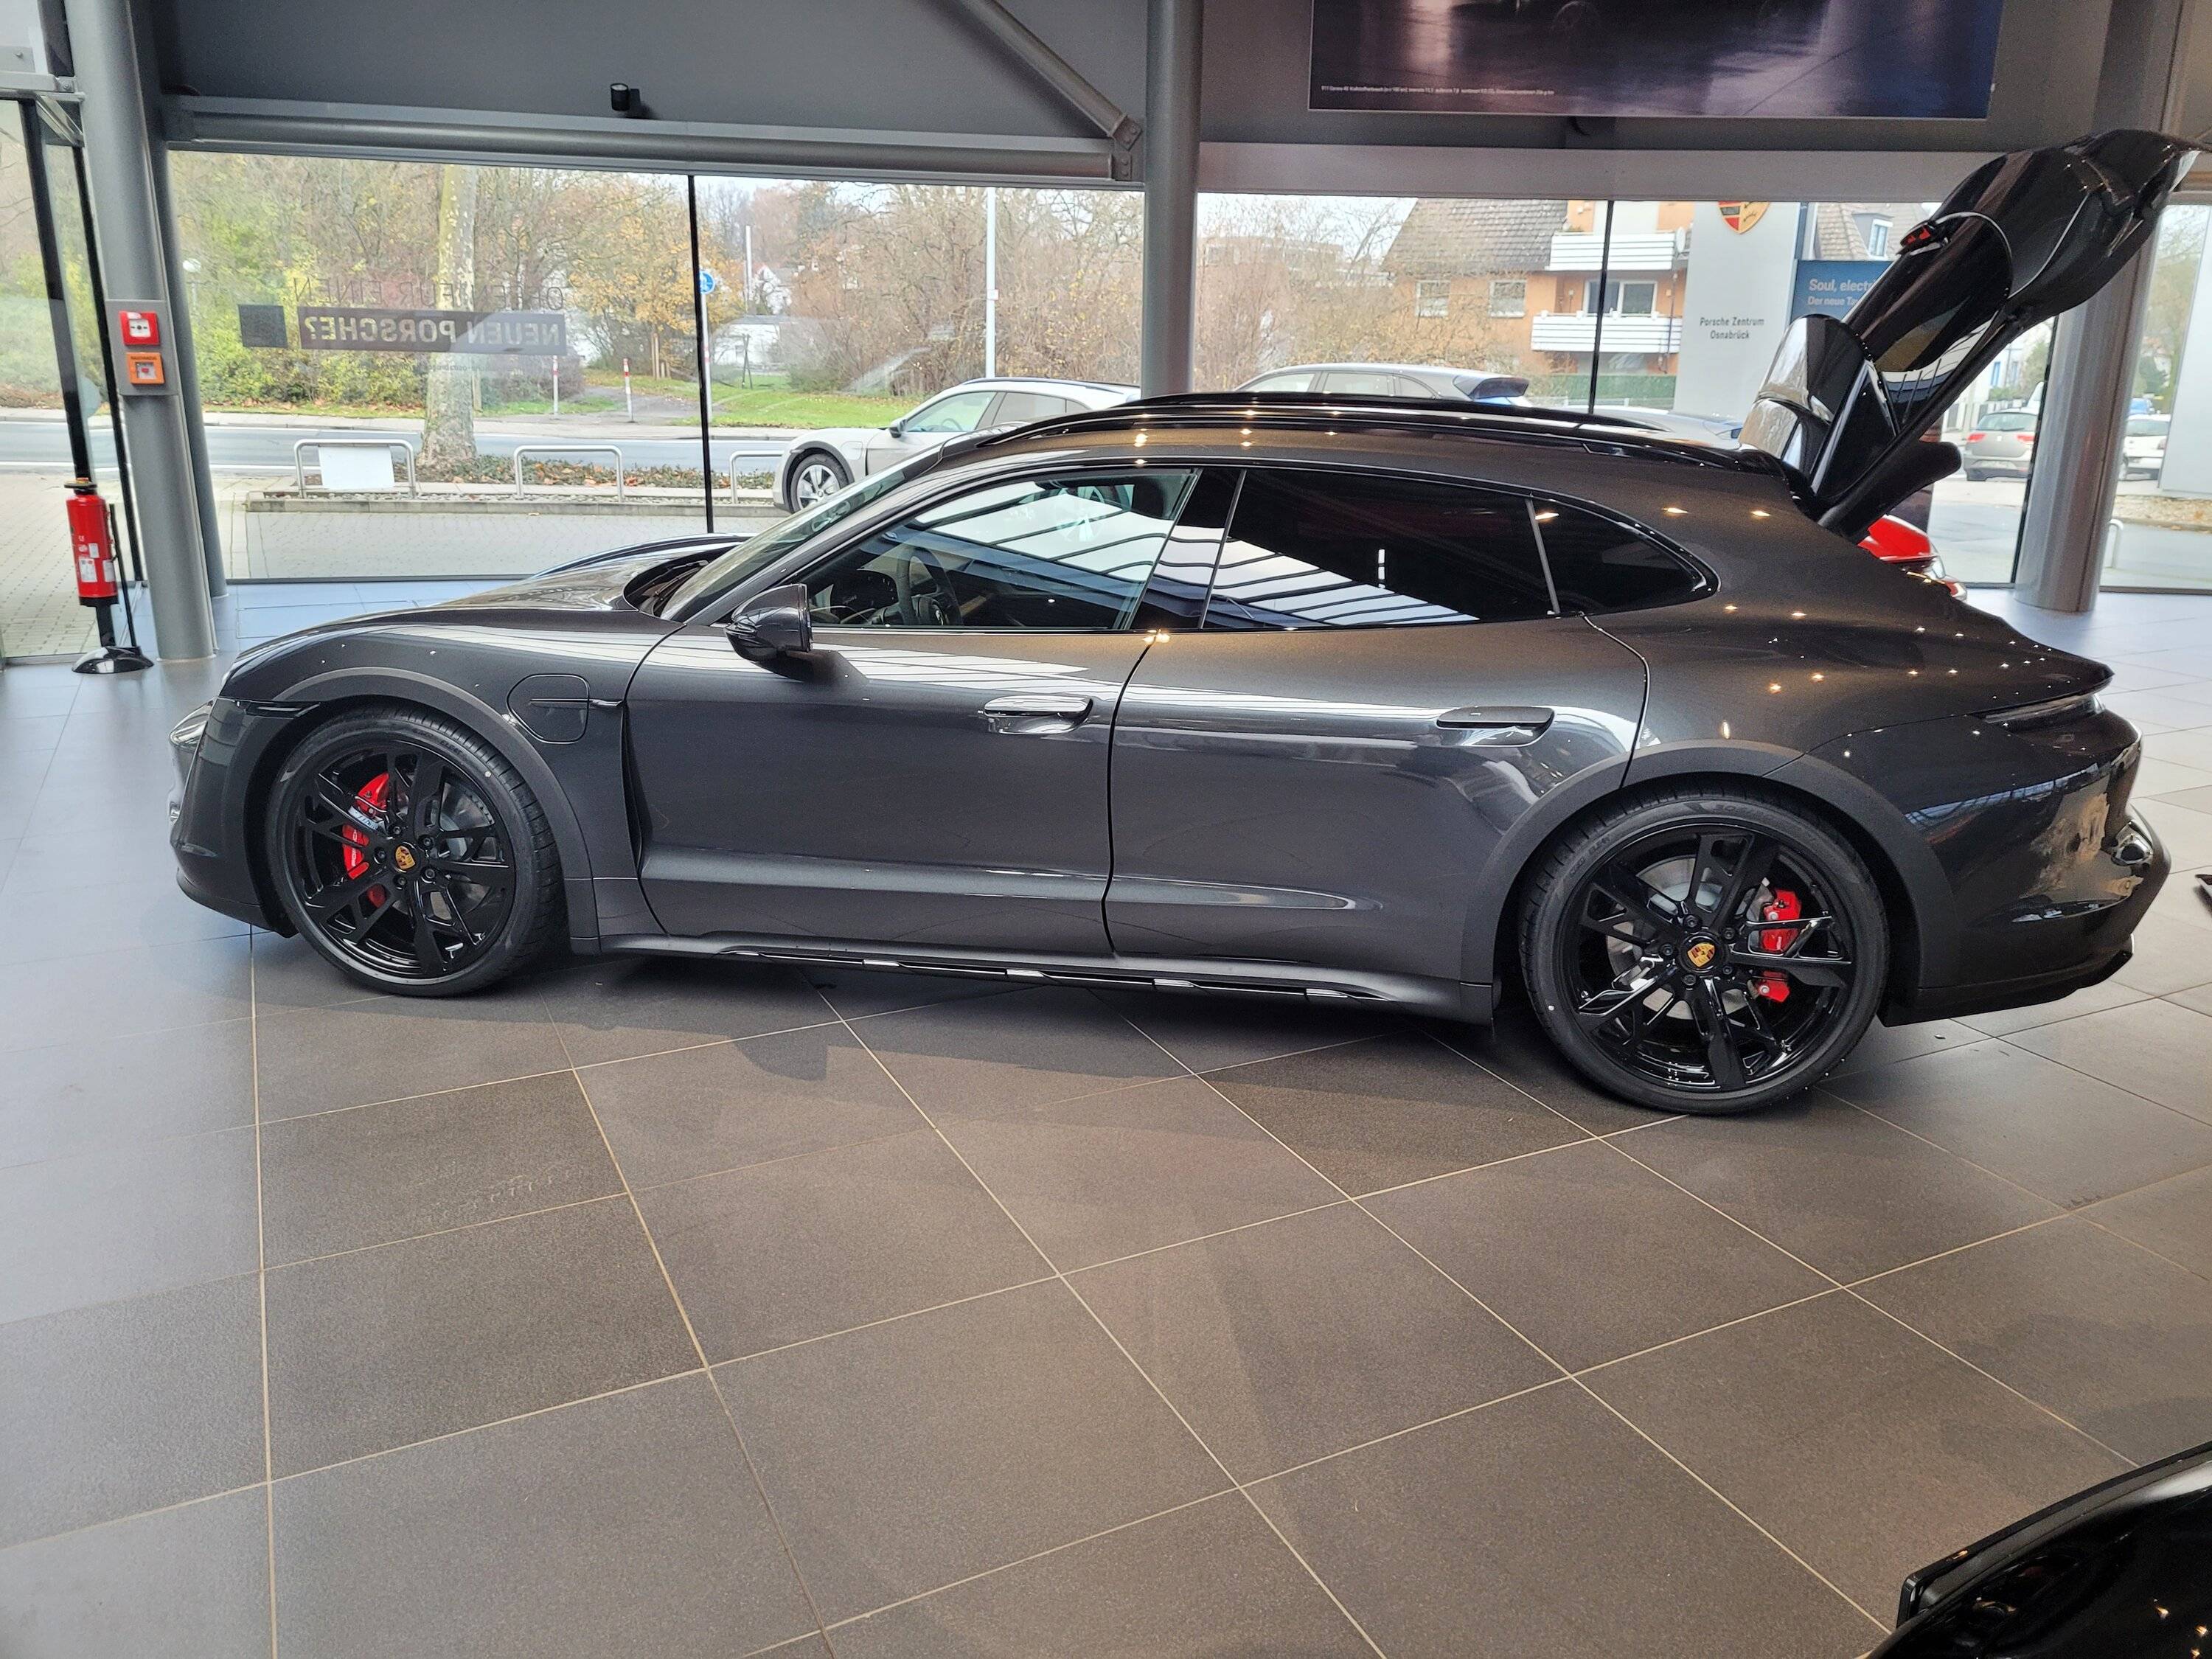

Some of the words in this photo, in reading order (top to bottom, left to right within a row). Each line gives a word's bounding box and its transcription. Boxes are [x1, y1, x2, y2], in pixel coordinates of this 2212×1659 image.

[1809, 278, 1837, 293] Soul,
[1840, 279, 1876, 292] electr
[1807, 296, 1823, 305] Der
[1823, 297, 1845, 306] neue
[1700, 317, 1730, 326] Porsche
[1731, 316, 1764, 326] Zentrum
[1710, 330, 1749, 339] Osnabrück
